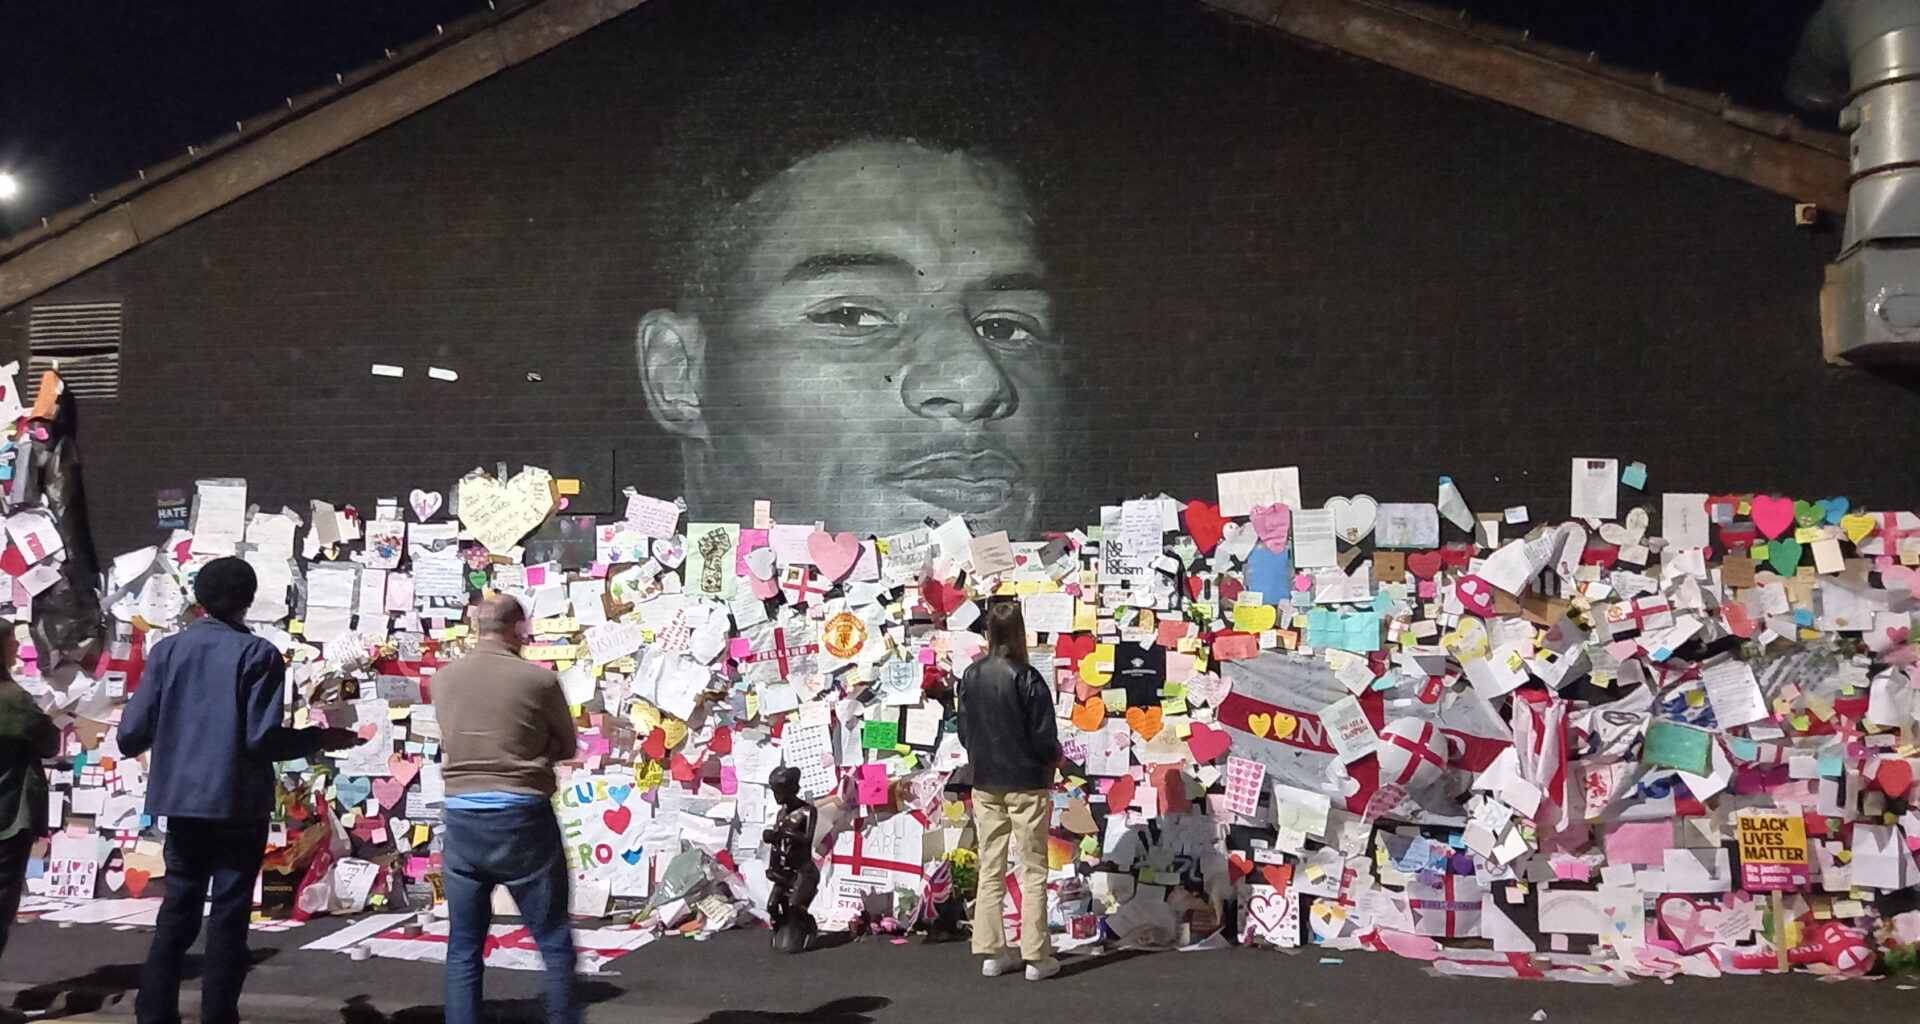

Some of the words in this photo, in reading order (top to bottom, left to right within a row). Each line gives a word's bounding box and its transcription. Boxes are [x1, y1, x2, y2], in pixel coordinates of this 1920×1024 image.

[158, 507, 188, 518] HATE
[1106, 540, 1123, 552] No
[1106, 563, 1143, 574] racism
[756, 645, 807, 661] ENGLAND
[1741, 818, 1789, 831] BLACK
[1743, 832, 1784, 845] LIVES
[1744, 847, 1804, 860] MATTER
[1742, 943, 1824, 960] ENGAND
